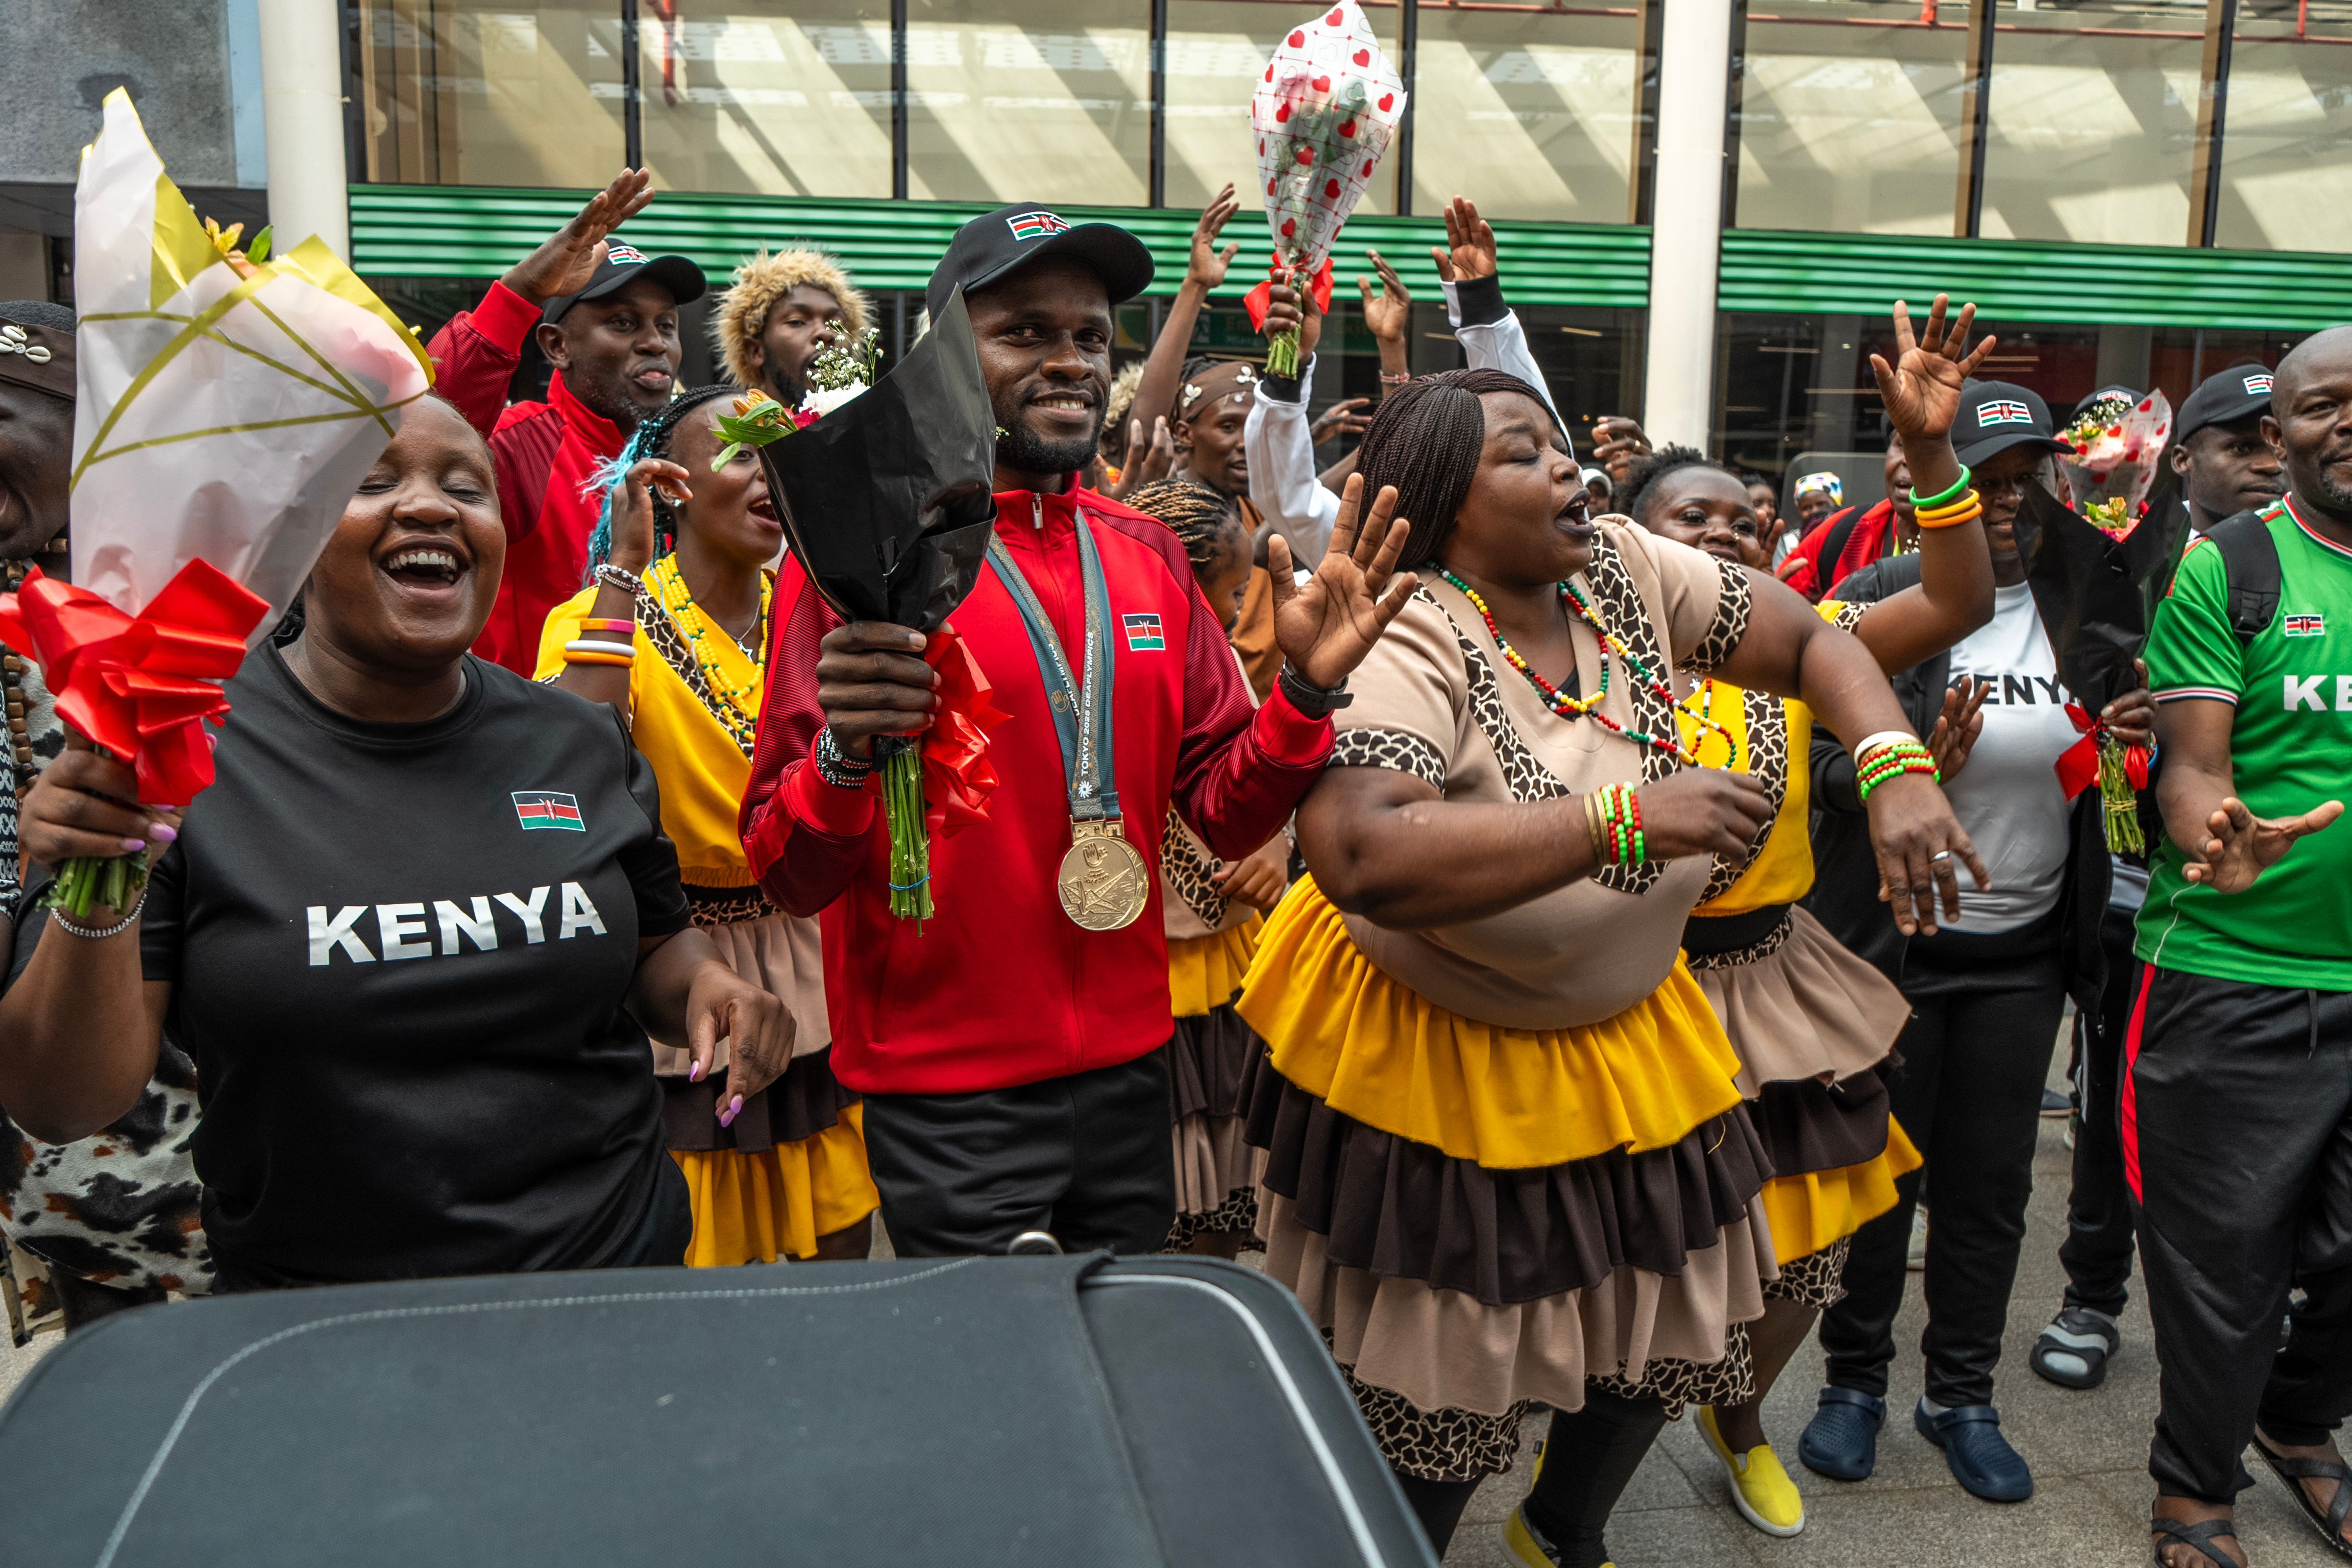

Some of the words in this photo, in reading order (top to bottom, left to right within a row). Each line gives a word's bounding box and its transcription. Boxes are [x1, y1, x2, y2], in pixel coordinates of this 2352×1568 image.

[1081, 737, 1089, 776] TOKYO
[1085, 631, 1094, 707] DEAFLYMPICS
[306, 881, 607, 966] KENYA
